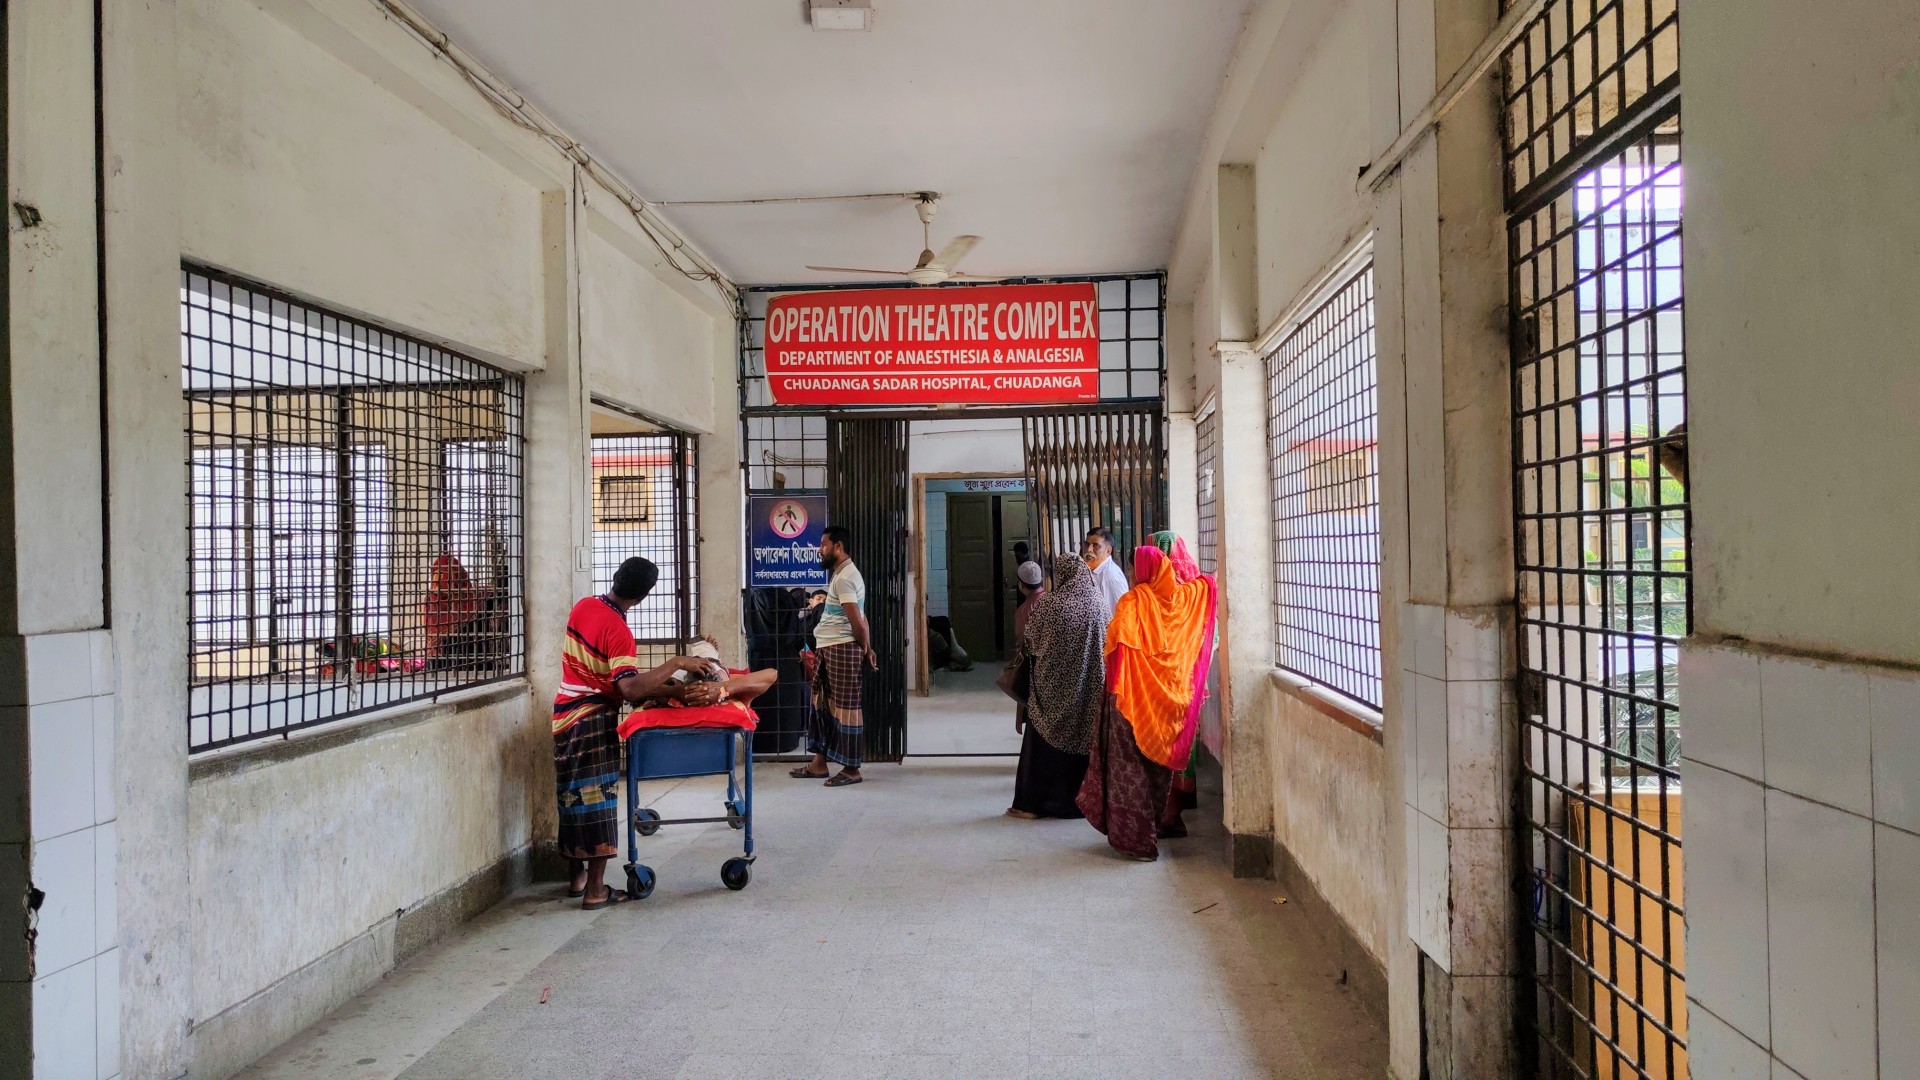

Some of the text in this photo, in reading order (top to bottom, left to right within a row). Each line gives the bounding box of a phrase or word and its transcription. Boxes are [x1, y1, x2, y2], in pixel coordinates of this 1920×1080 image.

[769, 300, 1096, 343] OPERATION THEATRE COMPLEX
[779, 347, 1084, 366] DEPARTMENT OF ANAESTHESIA & ANALGESIA
[783, 374, 1082, 391] CHUADANGA SADAR HOSPITAL, CHUADANGA
[995, 479, 1016, 489] প্রবেশ
[753, 545, 790, 565] অপারেশন
[754, 568, 824, 580] সর্বসাধারণের প্রবেশ নিষেধ
